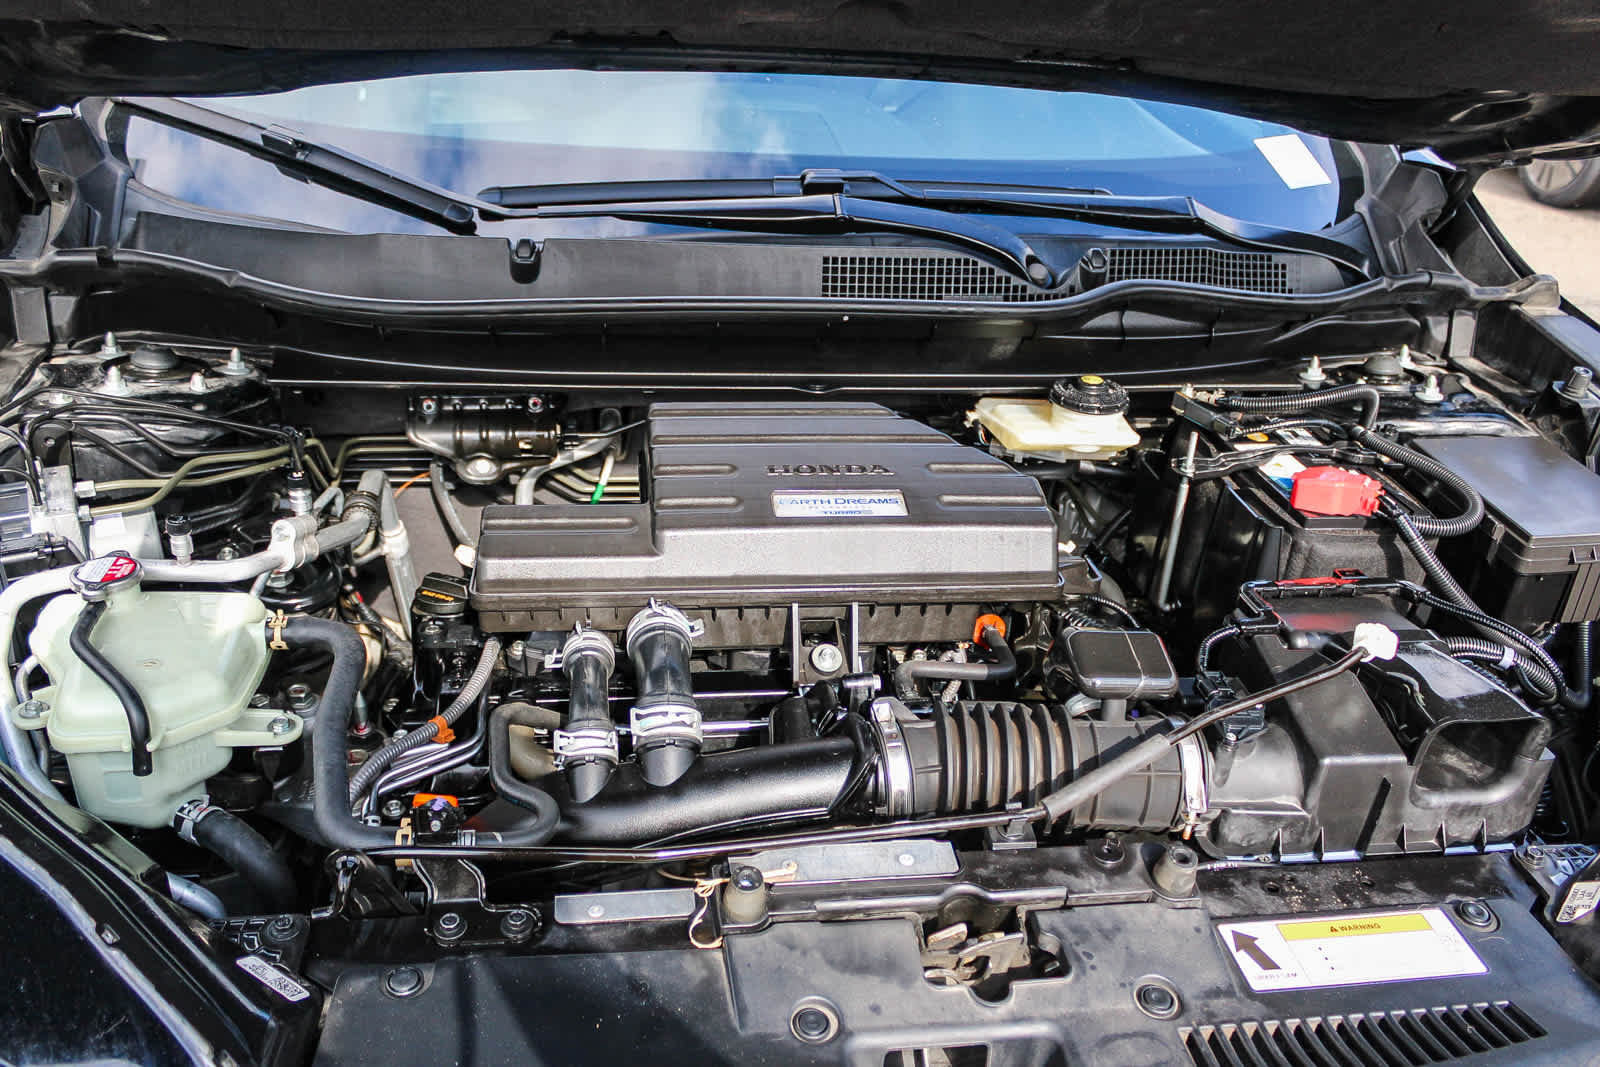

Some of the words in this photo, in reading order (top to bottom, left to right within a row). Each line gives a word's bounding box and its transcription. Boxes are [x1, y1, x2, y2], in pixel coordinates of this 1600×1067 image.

[766, 464, 895, 476] HONDA
[834, 497, 899, 505] DREAMS
[1339, 923, 1381, 931] WARNING
